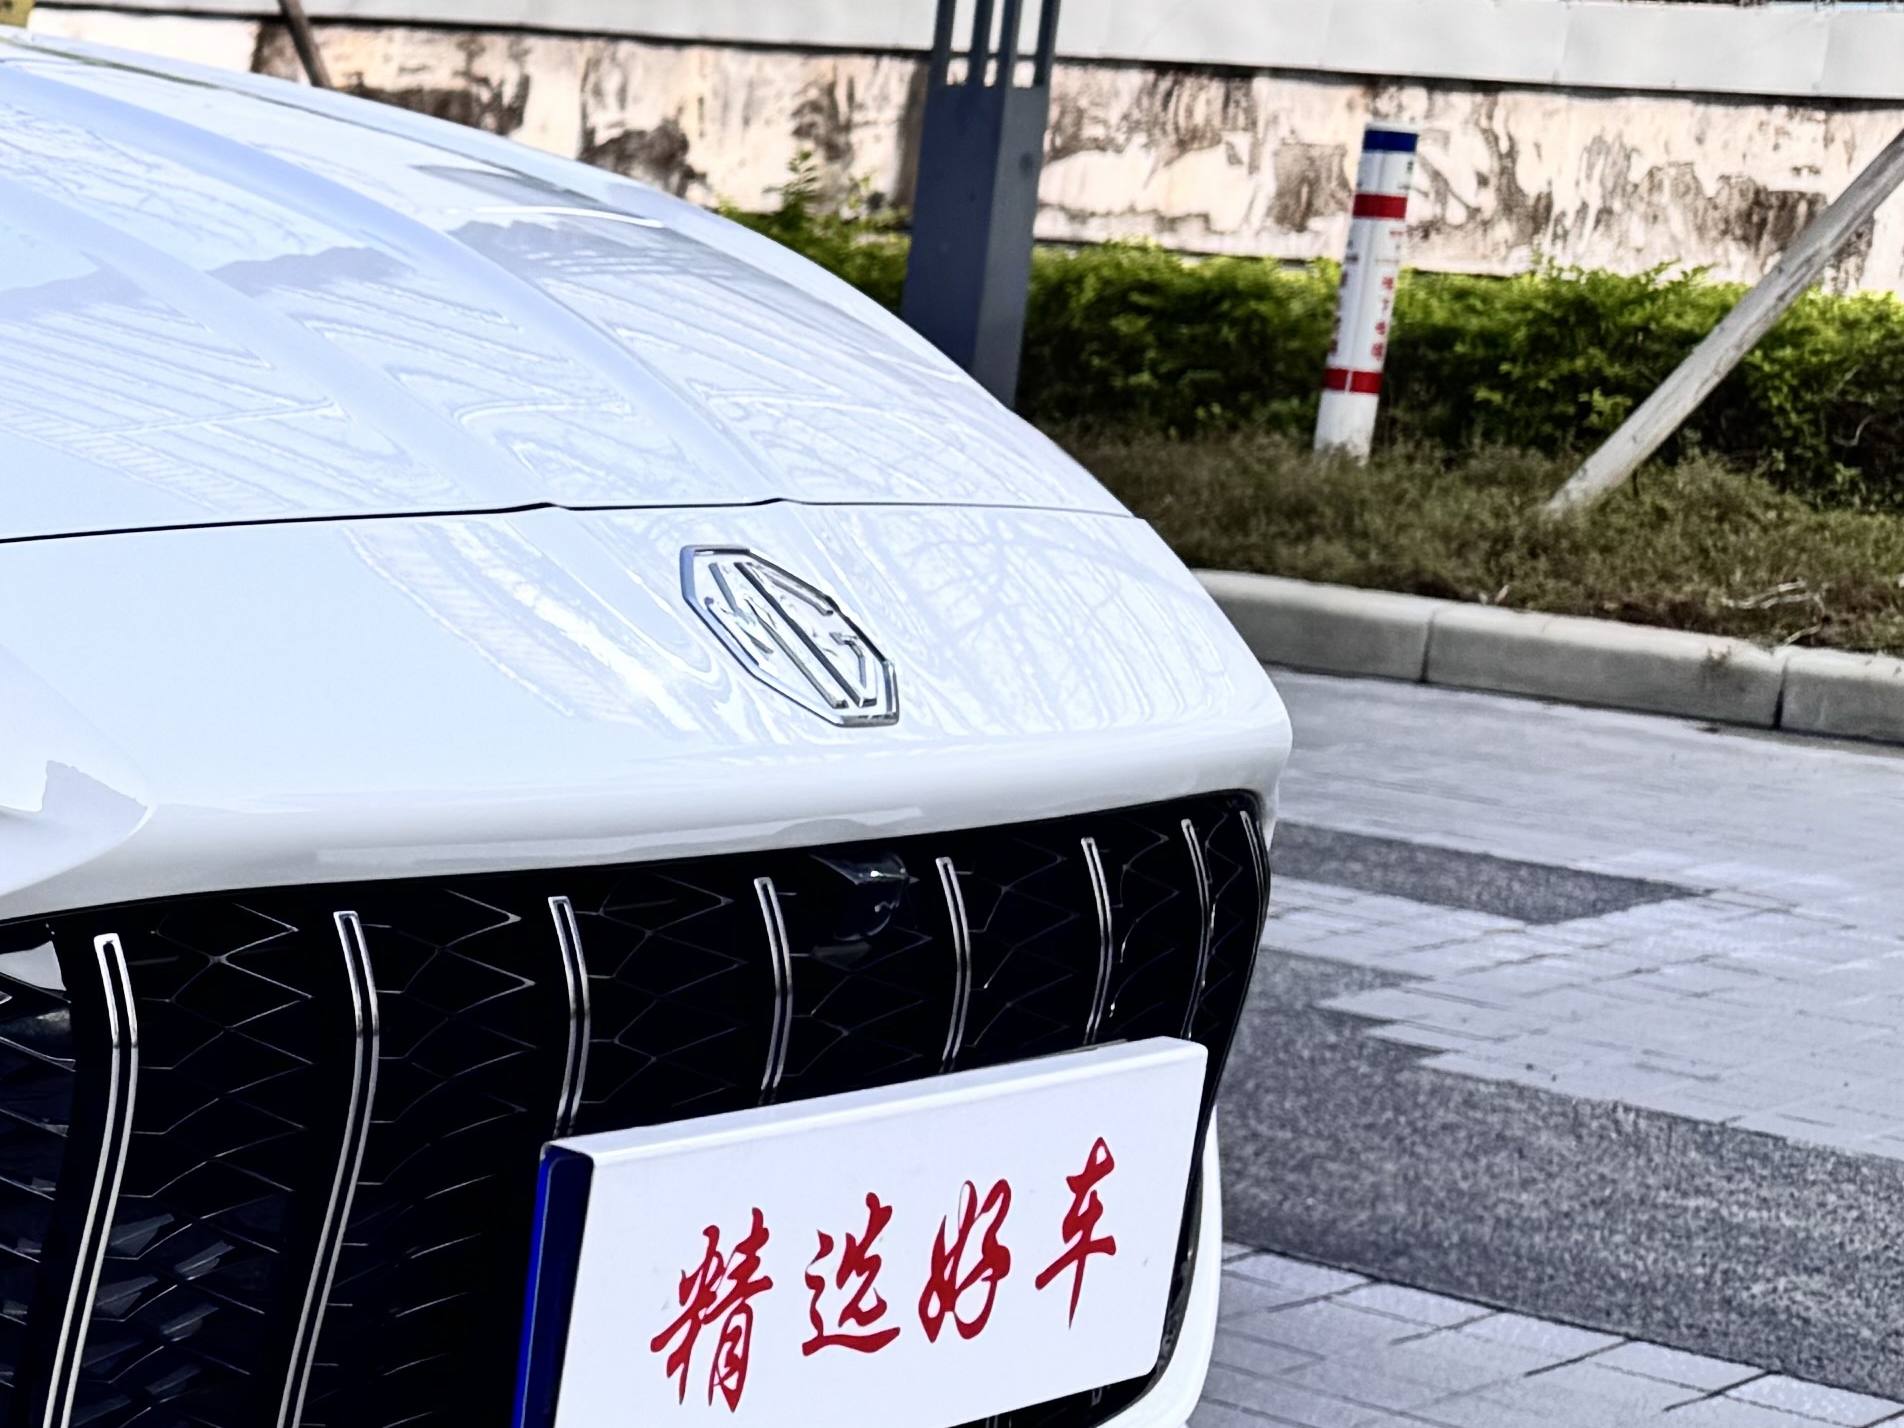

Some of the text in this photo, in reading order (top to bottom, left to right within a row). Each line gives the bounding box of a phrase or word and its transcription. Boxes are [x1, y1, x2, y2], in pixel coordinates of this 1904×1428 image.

[704, 560, 878, 709] MG
[650, 1136, 1117, 1413] 精选好车
